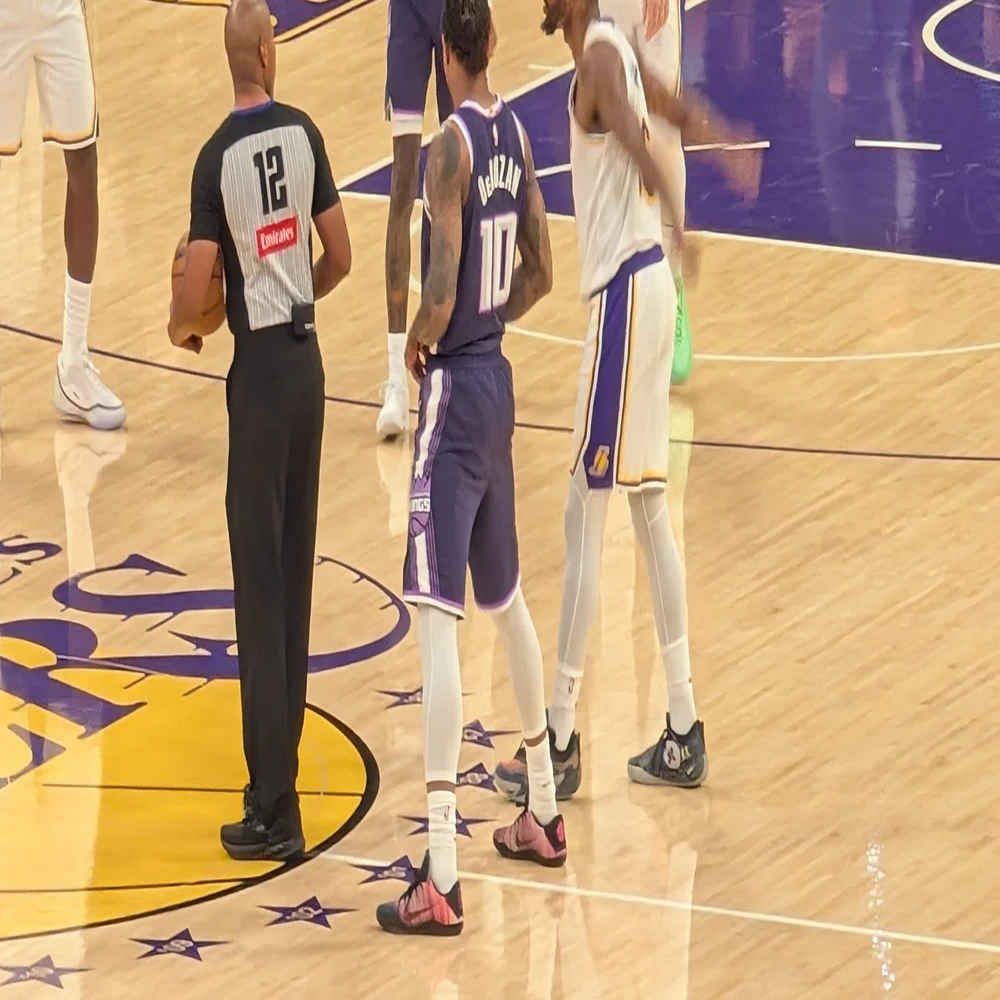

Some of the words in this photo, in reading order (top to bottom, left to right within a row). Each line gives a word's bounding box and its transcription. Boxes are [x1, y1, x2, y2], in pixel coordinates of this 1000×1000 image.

[253, 145, 289, 216] 12
[260, 225, 295, 251] Emirates
[478, 210, 519, 315] 10
